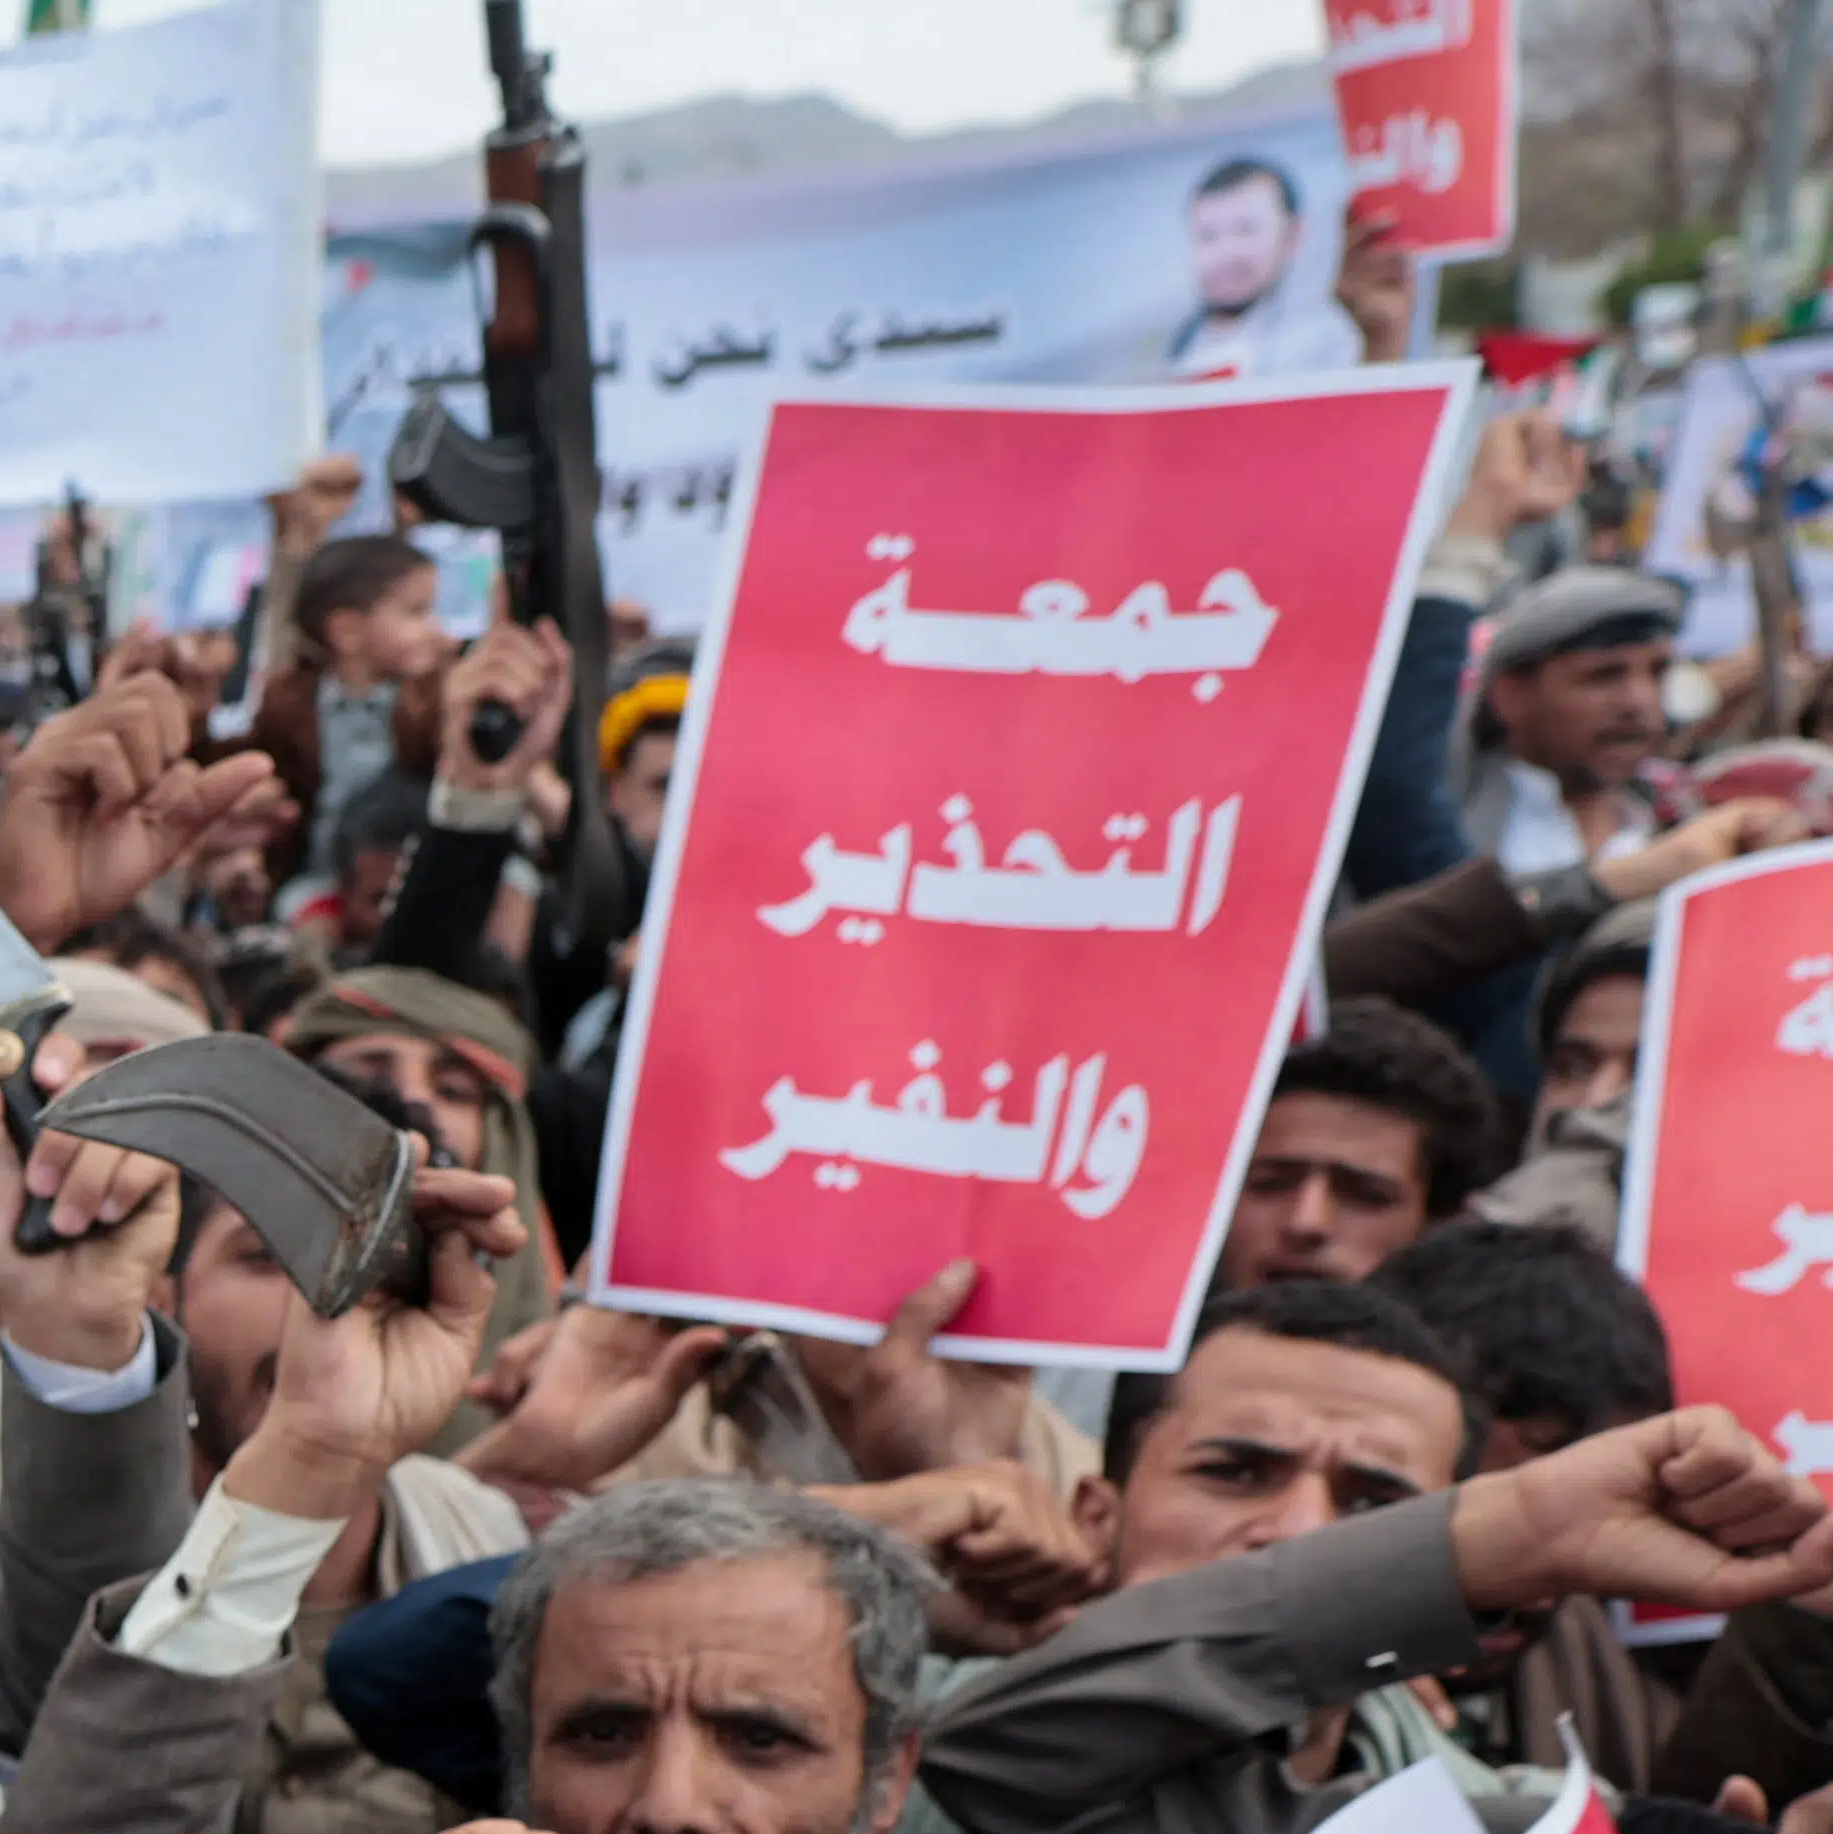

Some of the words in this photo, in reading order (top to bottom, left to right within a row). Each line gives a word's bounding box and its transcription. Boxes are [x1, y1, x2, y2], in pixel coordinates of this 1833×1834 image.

[841, 534, 1280, 702] جمعة
[755, 793, 1243, 946] التحذير
[718, 1038, 1150, 1221] والنفير
